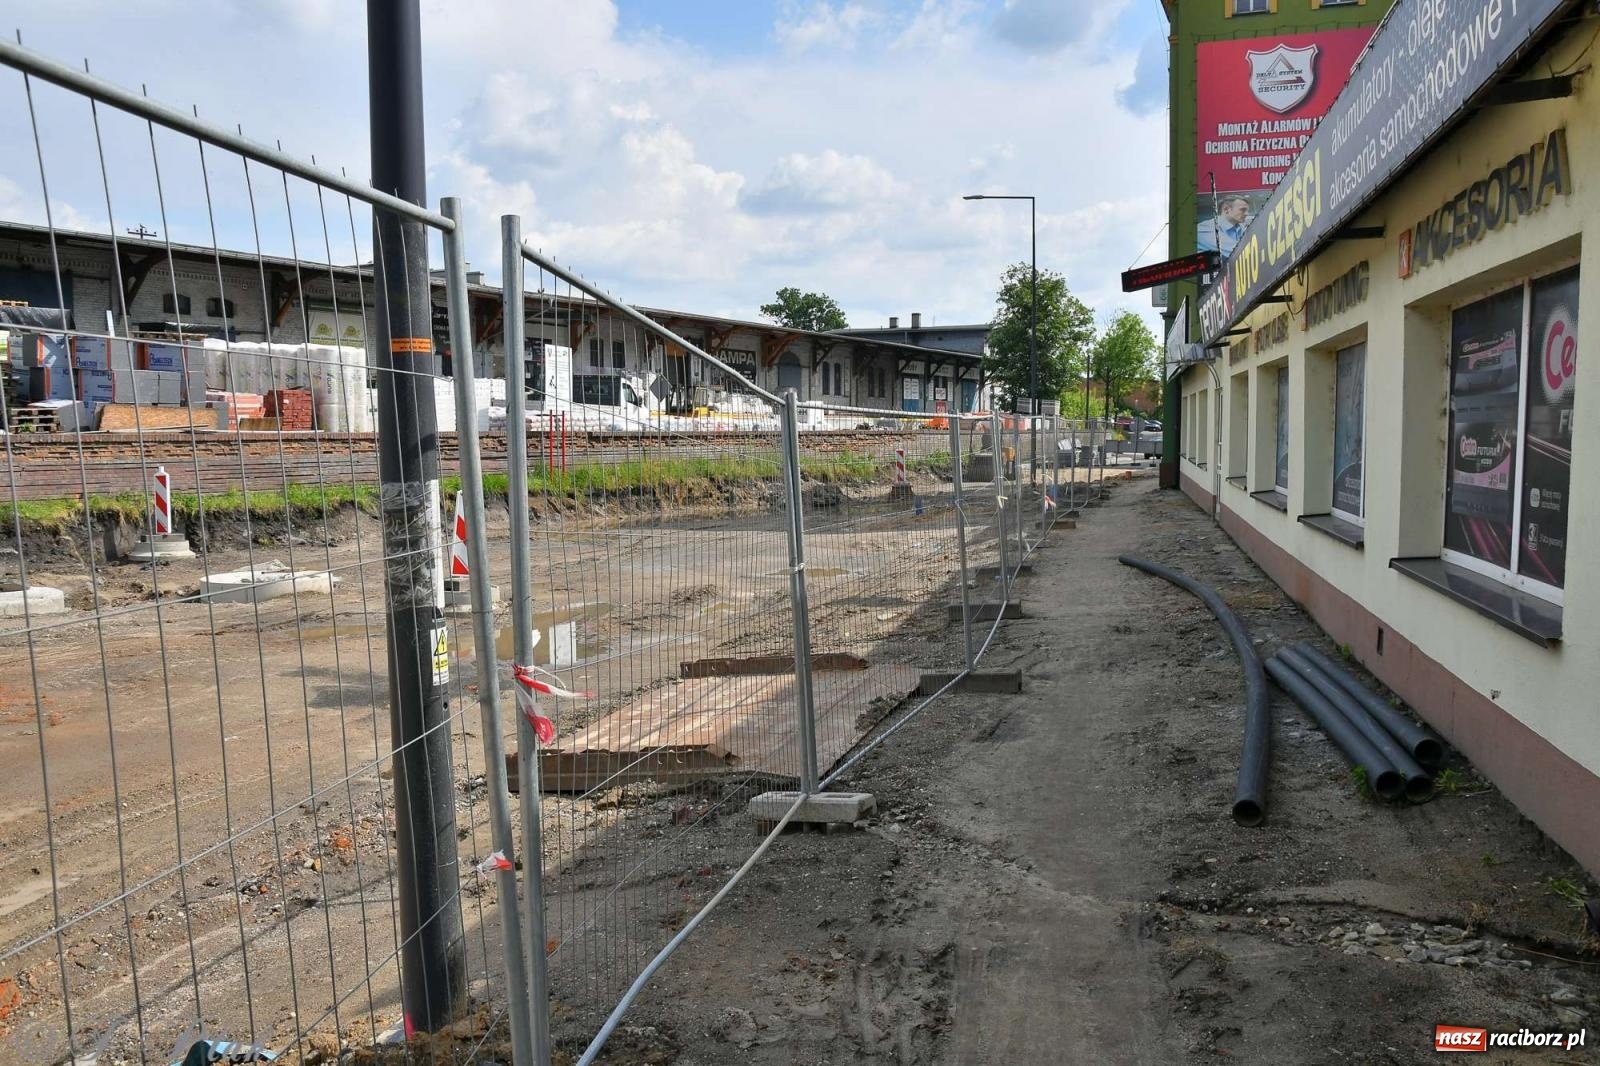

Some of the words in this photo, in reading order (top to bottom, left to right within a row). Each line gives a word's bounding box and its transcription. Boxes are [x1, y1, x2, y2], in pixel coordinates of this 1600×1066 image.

[1258, 83, 1306, 93] SECURITY
[1329, 135, 1377, 211] akcesoria
[1379, 0, 1502, 160] samochodowe
[1331, 48, 1395, 156] akumulatory
[1205, 139, 1249, 155] OCHRONA
[1250, 136, 1297, 152] FIZYCZNA
[1218, 120, 1259, 137] MONTAŻ
[1260, 117, 1312, 134] ALARMÓW
[1232, 153, 1291, 170] MONITORING
[1235, 234, 1260, 303] AUTO
[1267, 149, 1321, 267] CZĘŚCI
[1412, 129, 1571, 272] AKCESORIA
[1545, 320, 1577, 390] Ce
